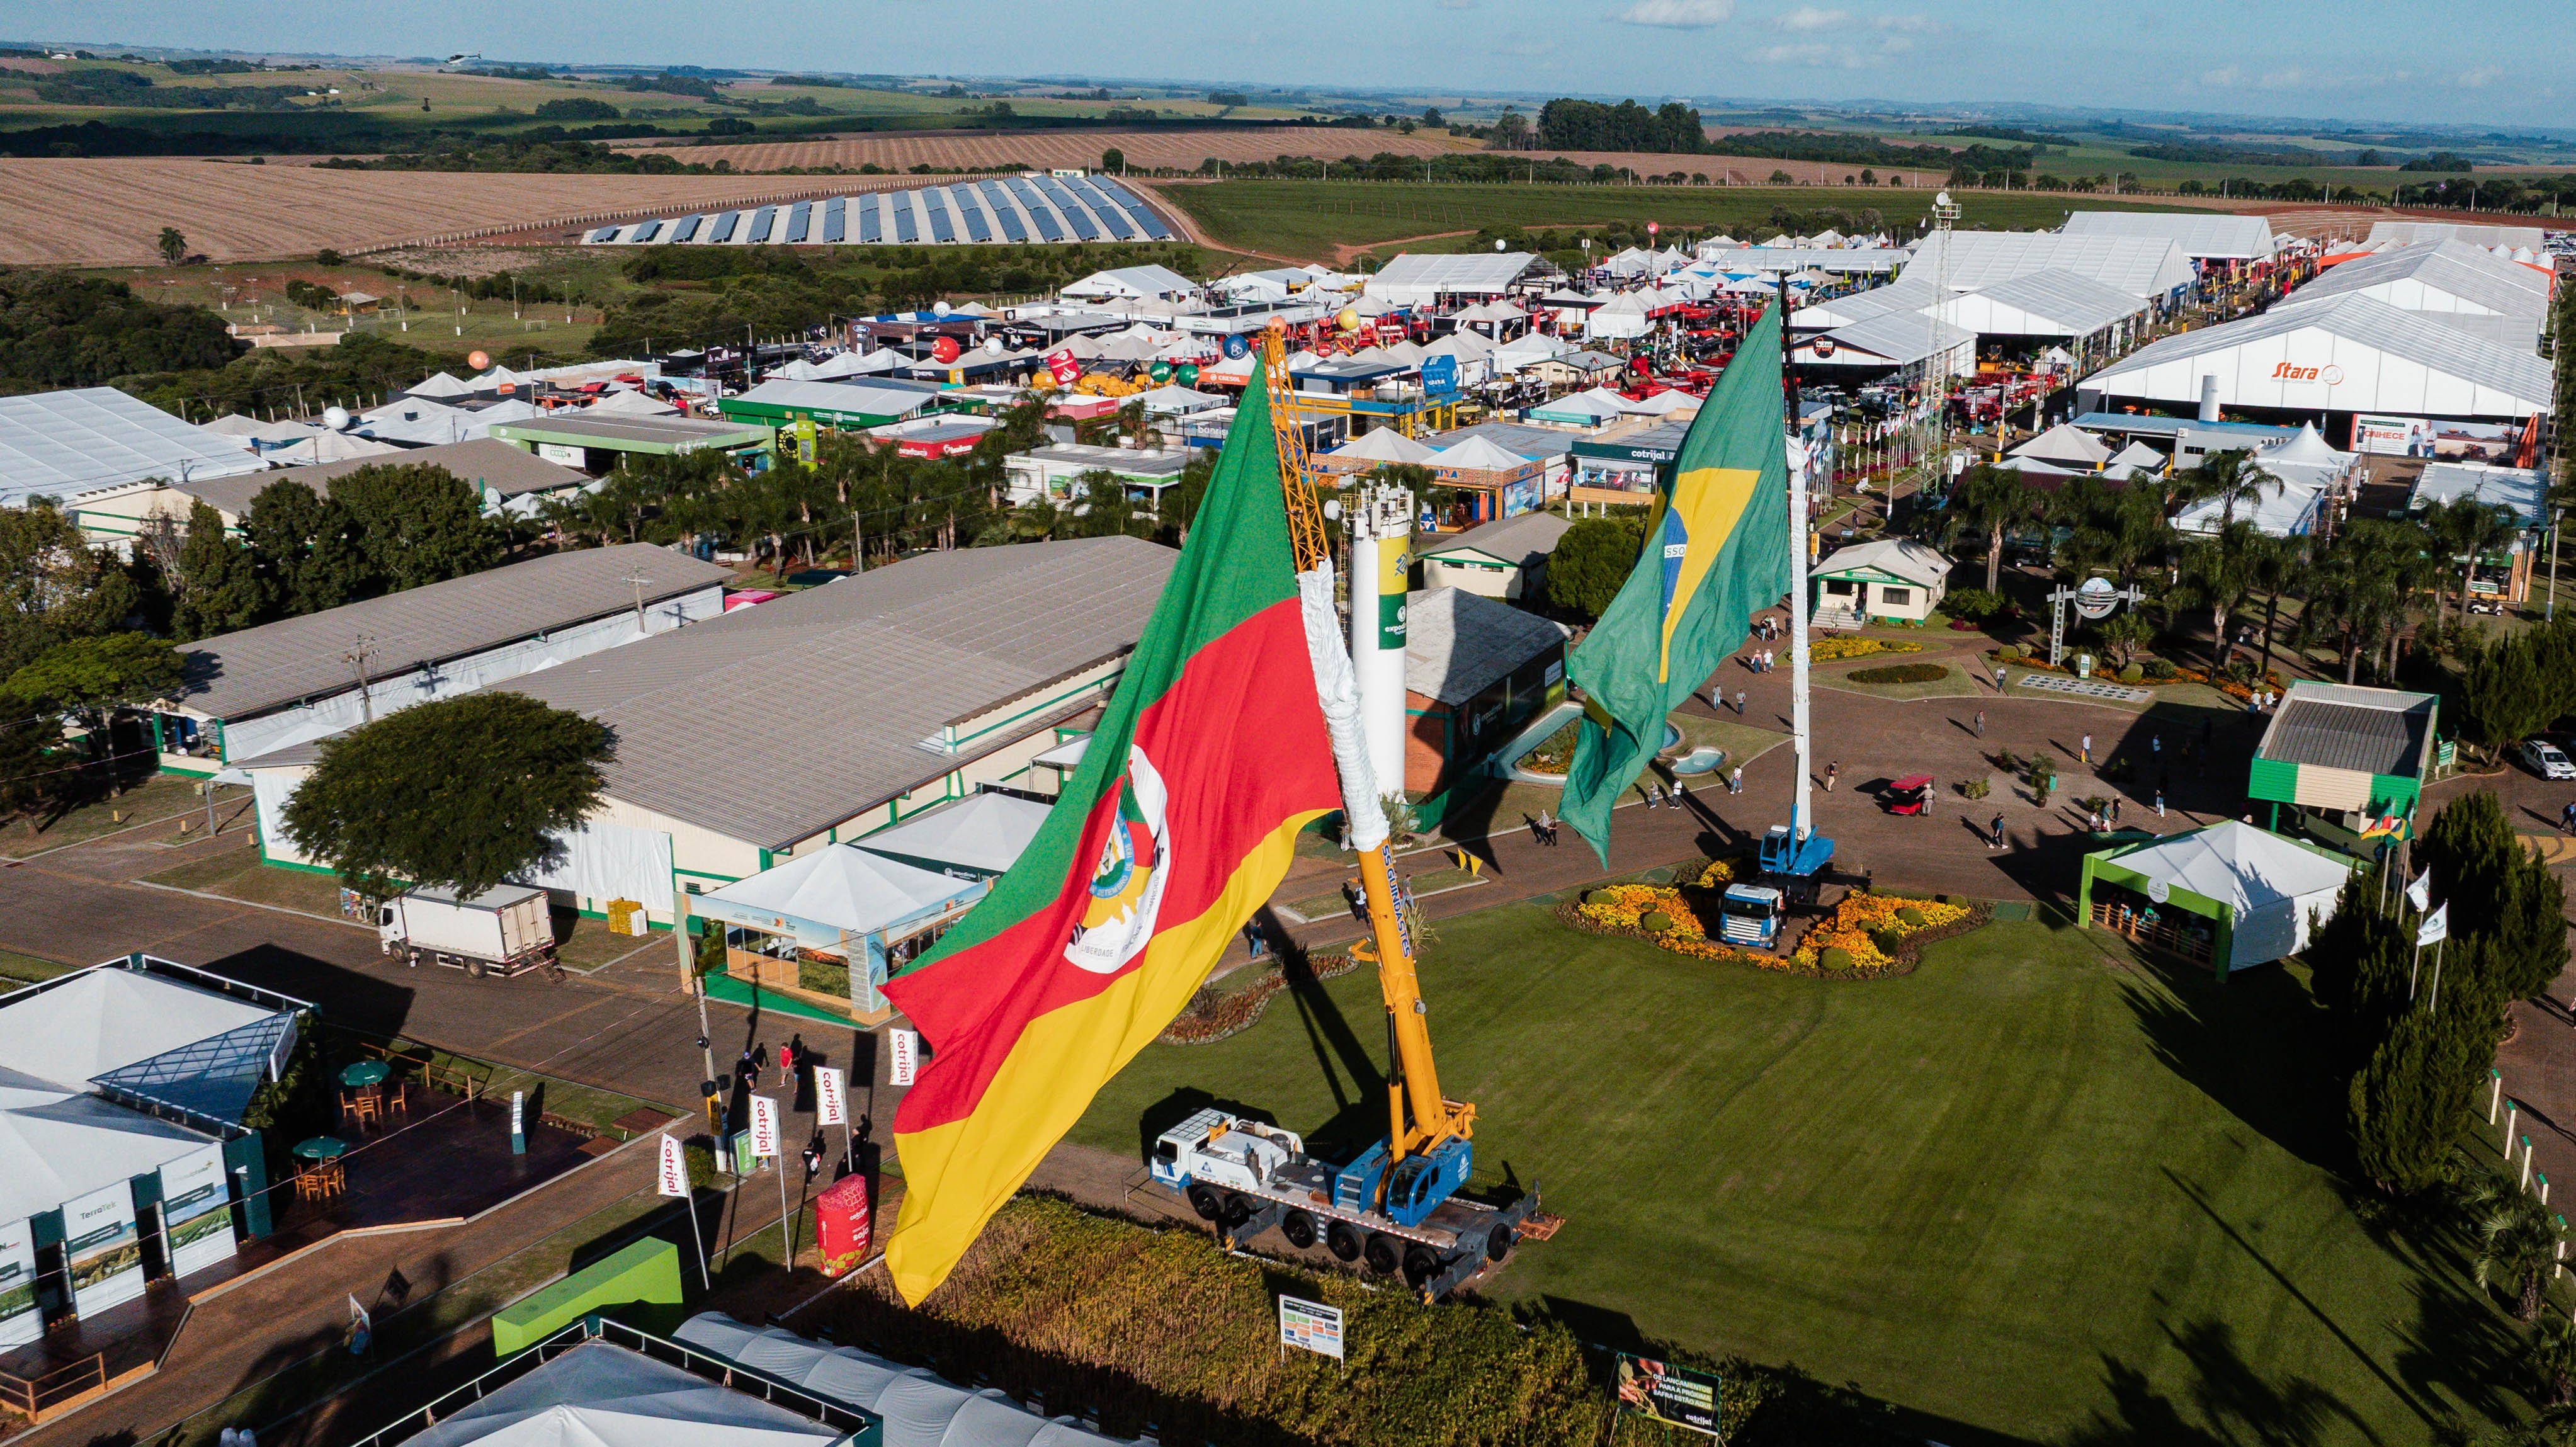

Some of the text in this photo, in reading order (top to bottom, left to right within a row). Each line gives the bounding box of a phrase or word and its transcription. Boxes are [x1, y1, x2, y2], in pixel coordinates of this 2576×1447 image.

[1218, 375, 1240, 383] CRESOL
[2271, 362, 2319, 380] Stara
[2364, 429, 2405, 440] ONHECE
[1631, 450, 1665, 461] cotrijal
[1435, 469, 1458, 479] AIXA
[1665, 546, 1685, 557] SSO
[1852, 572, 1892, 581] ADMINISTRAÇÃO
[1081, 943, 1114, 958] LIBERDADE
[897, 1033, 911, 1083] cotrijal
[824, 1071, 840, 1121] cotrijal
[757, 1101, 771, 1155] cotrijal
[665, 1140, 680, 1193] cotrijal
[80, 1201, 116, 1220] TerraTek
[849, 1205, 868, 1221] cotrijal
[853, 1227, 870, 1241] soja
[1659, 1382, 1675, 1393] PARA
[1681, 1388, 1711, 1402] PRÓXIMA
[1662, 1375, 1711, 1393] LANÇAMENTOS
[1653, 1389, 1711, 1409] SAFRA ESTÃO AQUI
[1685, 1413, 1712, 1426] cotrijal
